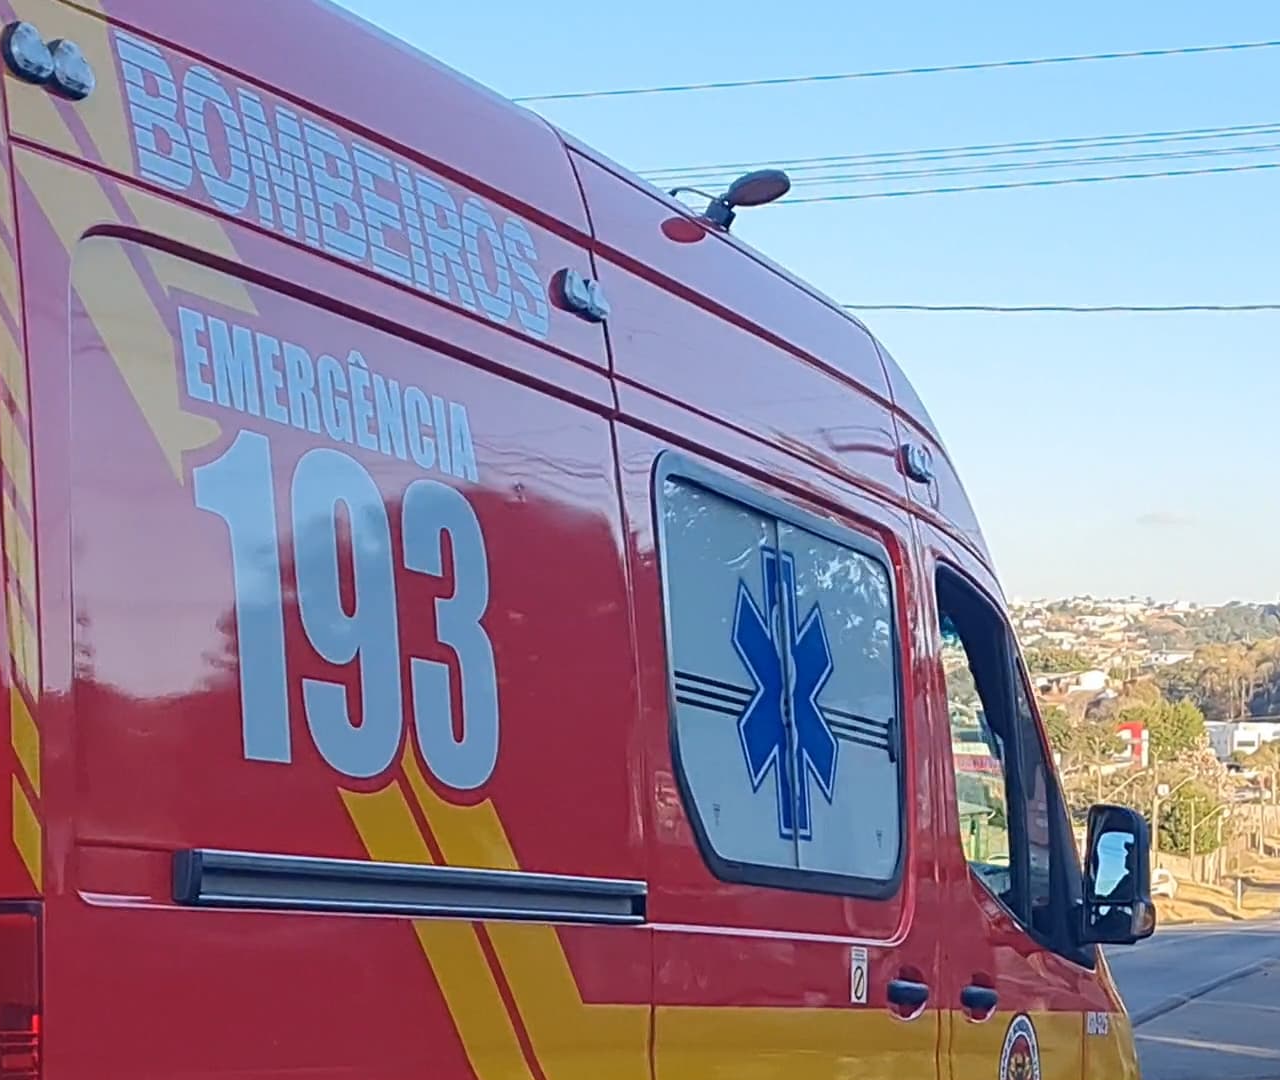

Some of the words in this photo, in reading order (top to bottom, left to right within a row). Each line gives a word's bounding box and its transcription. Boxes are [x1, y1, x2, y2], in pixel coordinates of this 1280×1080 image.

[114, 28, 551, 340] BOMBEIROS
[177, 305, 480, 483] EMERGÊNCIA
[192, 428, 500, 791] 193
